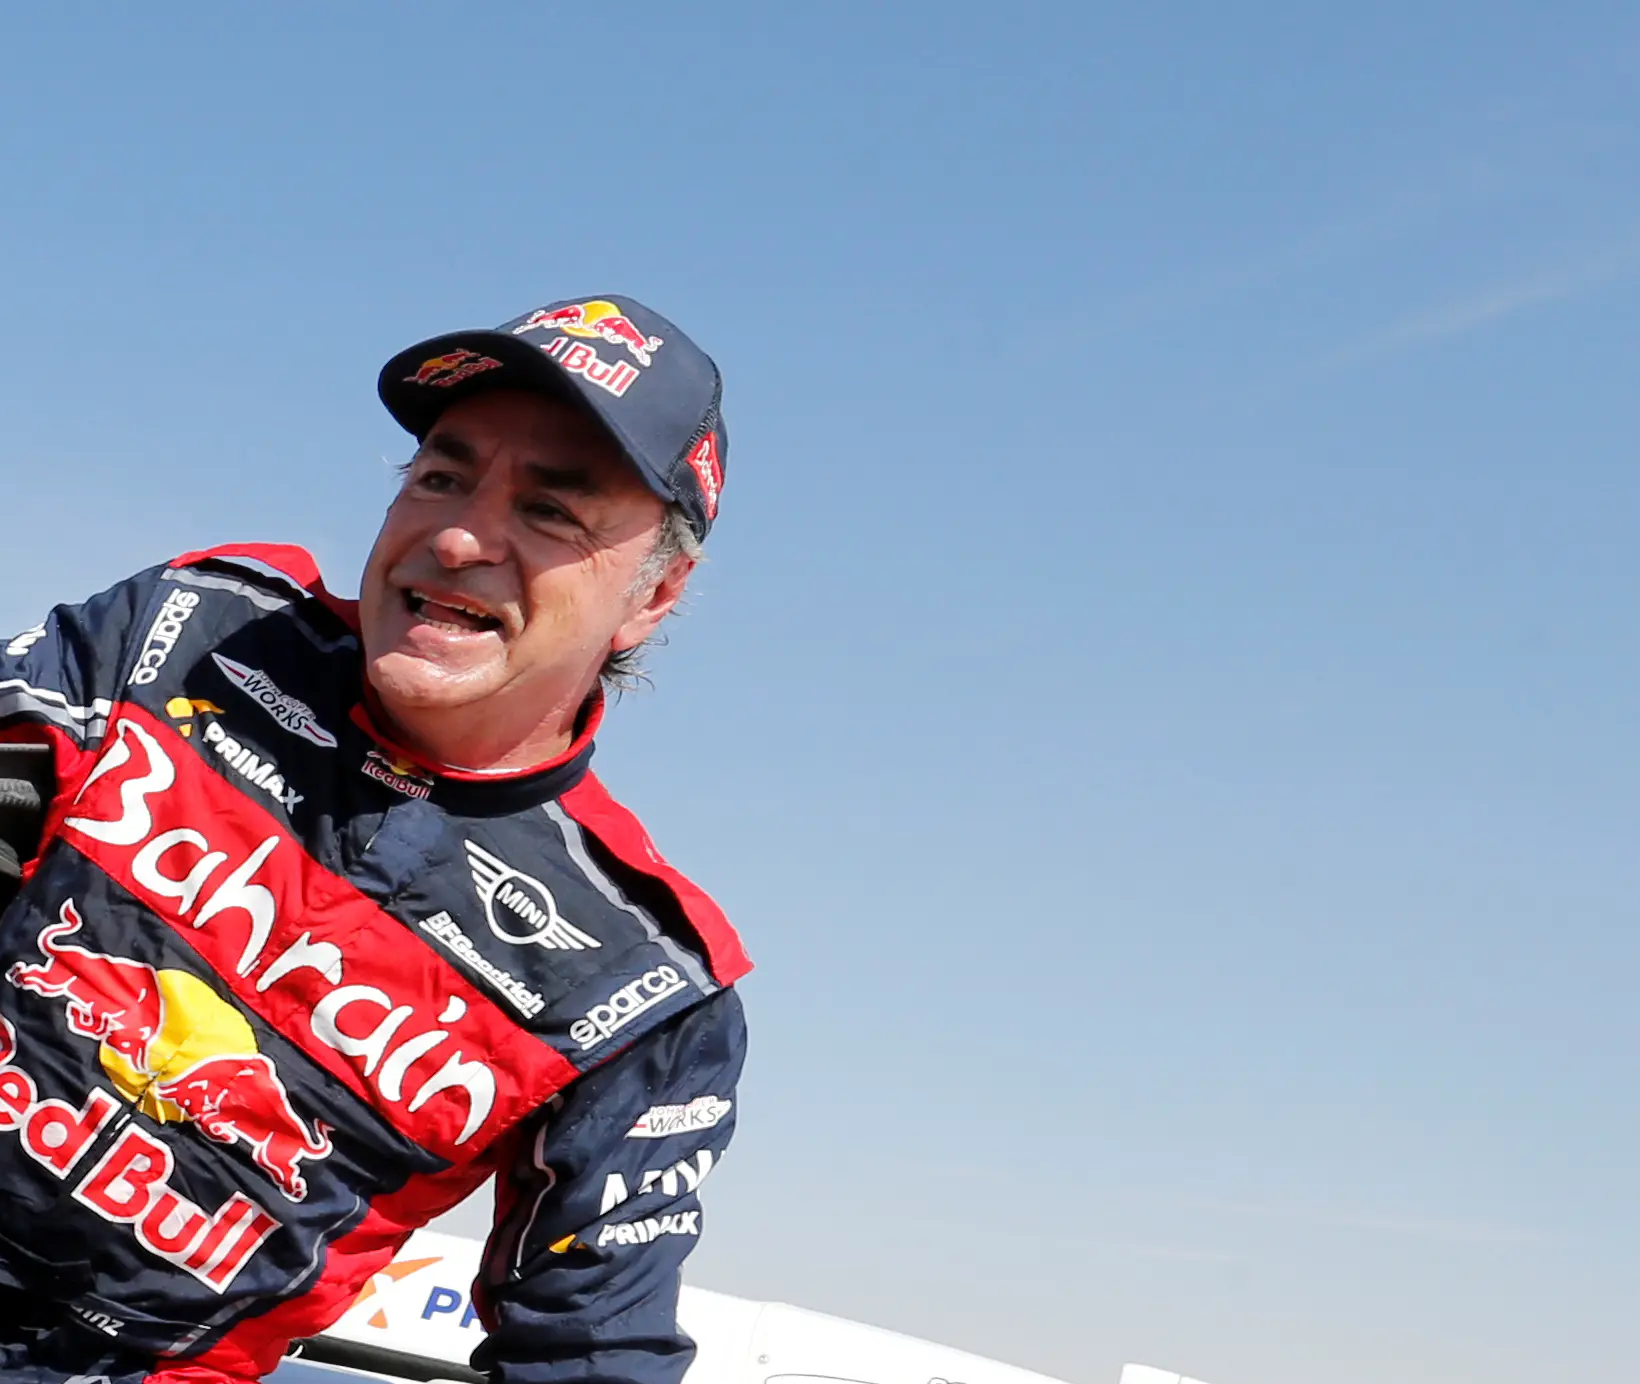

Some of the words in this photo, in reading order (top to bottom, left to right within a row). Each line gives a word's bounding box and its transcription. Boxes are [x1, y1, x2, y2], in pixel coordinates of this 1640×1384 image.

[560, 342, 639, 396] Bull
[129, 588, 201, 685] sparco
[244, 675, 310, 730] WORKS
[202, 721, 305, 815] PRIMAX
[362, 760, 396, 788] Red
[394, 779, 431, 800] Bull
[64, 718, 497, 1146] Bahrain
[495, 882, 548, 930] MINI
[419, 911, 546, 1019] BFGoodrich
[570, 965, 688, 1051] sparco
[72, 1122, 282, 1294] Bull
